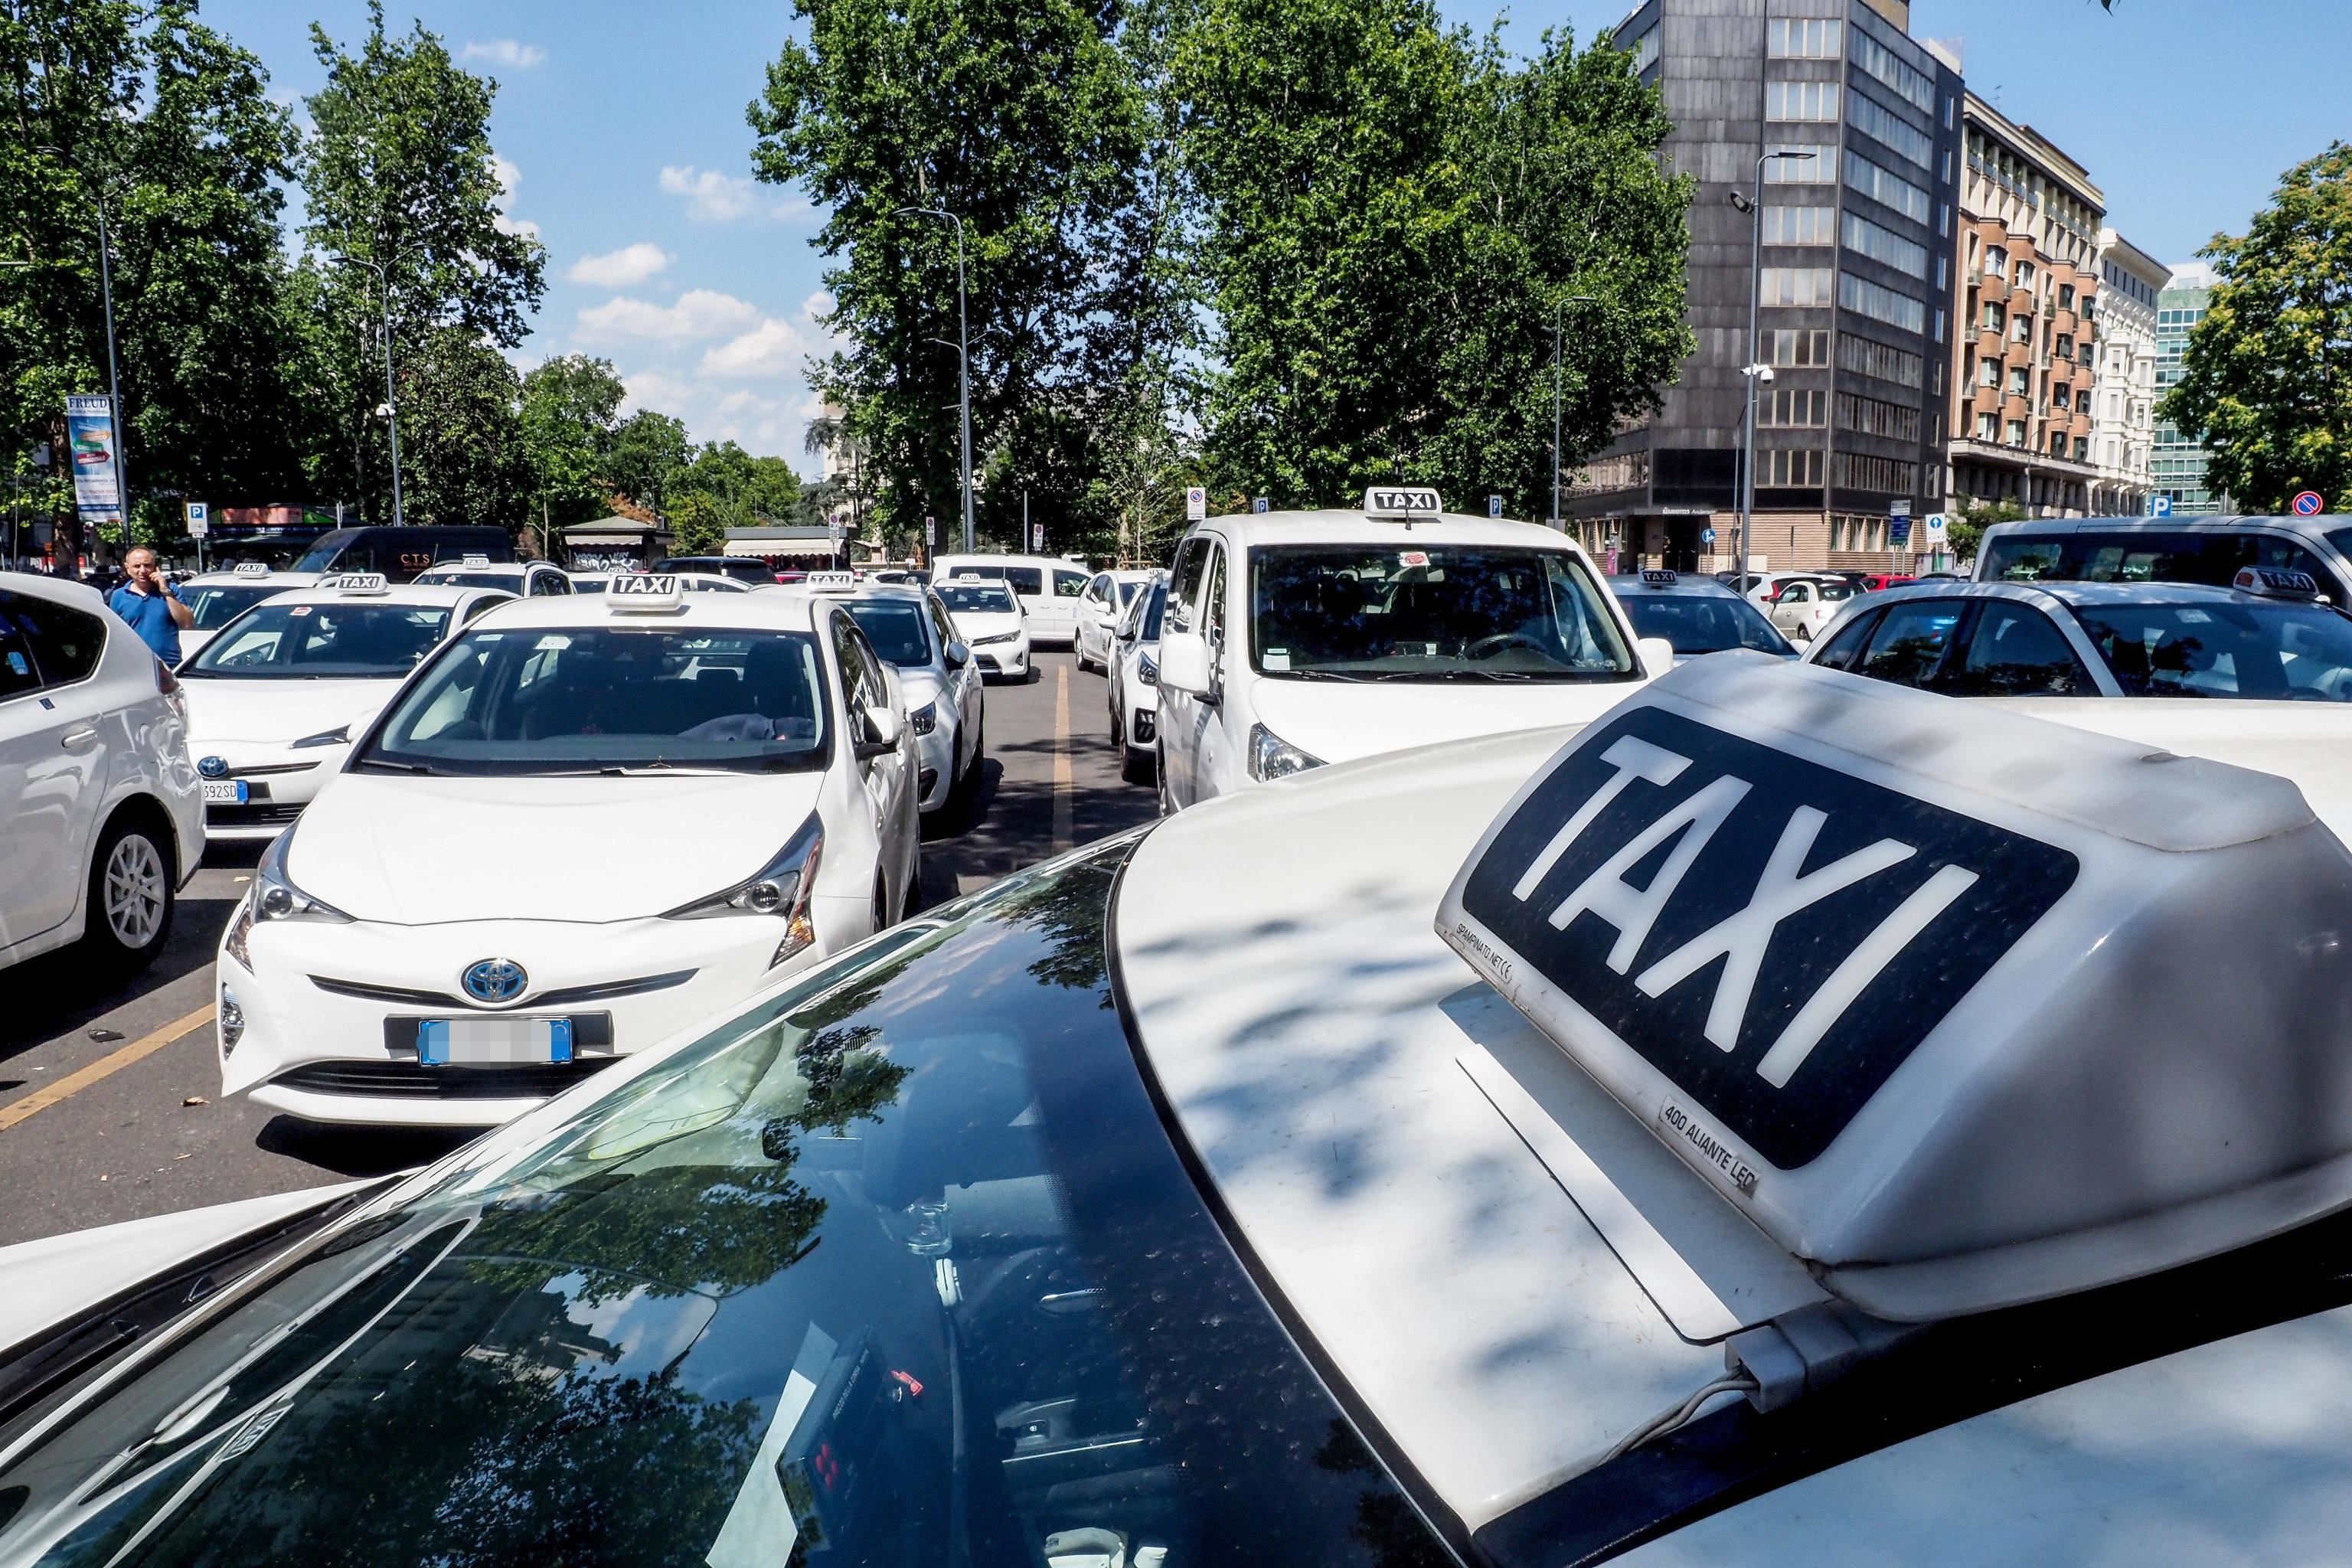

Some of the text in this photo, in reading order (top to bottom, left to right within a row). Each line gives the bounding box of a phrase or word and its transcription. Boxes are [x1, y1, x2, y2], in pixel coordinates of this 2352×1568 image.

[68, 397, 107, 408] FREUD
[1377, 493, 1432, 508] TAXI
[1493, 501, 1498, 512] P
[2153, 498, 2168, 516] P
[193, 507, 201, 517] P
[341, 577, 378, 588] TAXI
[812, 576, 848, 585] TAXI
[1644, 573, 1674, 581] TAXI
[2260, 572, 2311, 589] TAXI
[616, 577, 674, 593] TAXI
[1512, 734, 1980, 1089] TAXI
[1665, 1106, 1687, 1131] 400
[1686, 1124, 1733, 1171] ALIANTE
